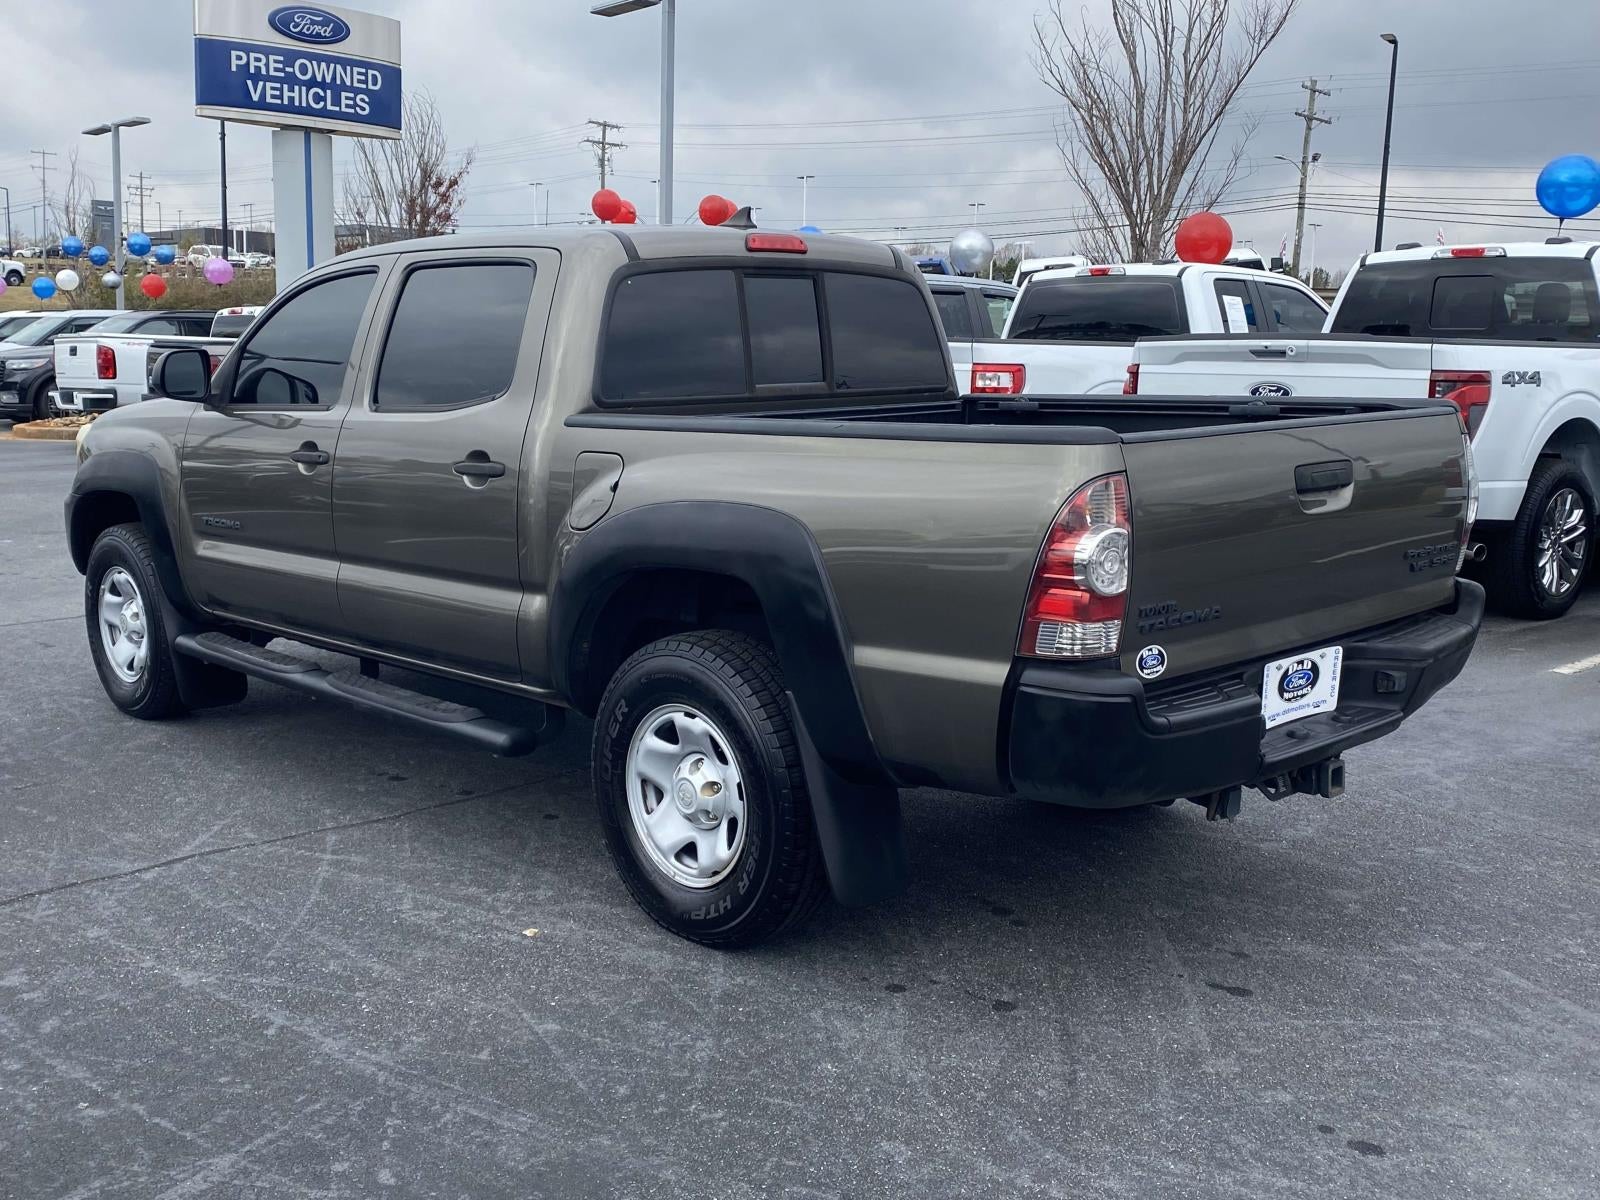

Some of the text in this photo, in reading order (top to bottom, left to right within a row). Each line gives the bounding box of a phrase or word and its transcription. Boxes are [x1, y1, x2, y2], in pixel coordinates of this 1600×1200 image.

[289, 13, 334, 38] Ford
[230, 50, 382, 91] PRE-OWNED
[246, 79, 370, 116] VEHICLES
[201, 516, 242, 530] TACOMA
[1137, 606, 1221, 634] TACOMA
[1288, 659, 1312, 676] D&D
[1289, 673, 1309, 689] Ford
[1283, 684, 1312, 700] MOTORS
